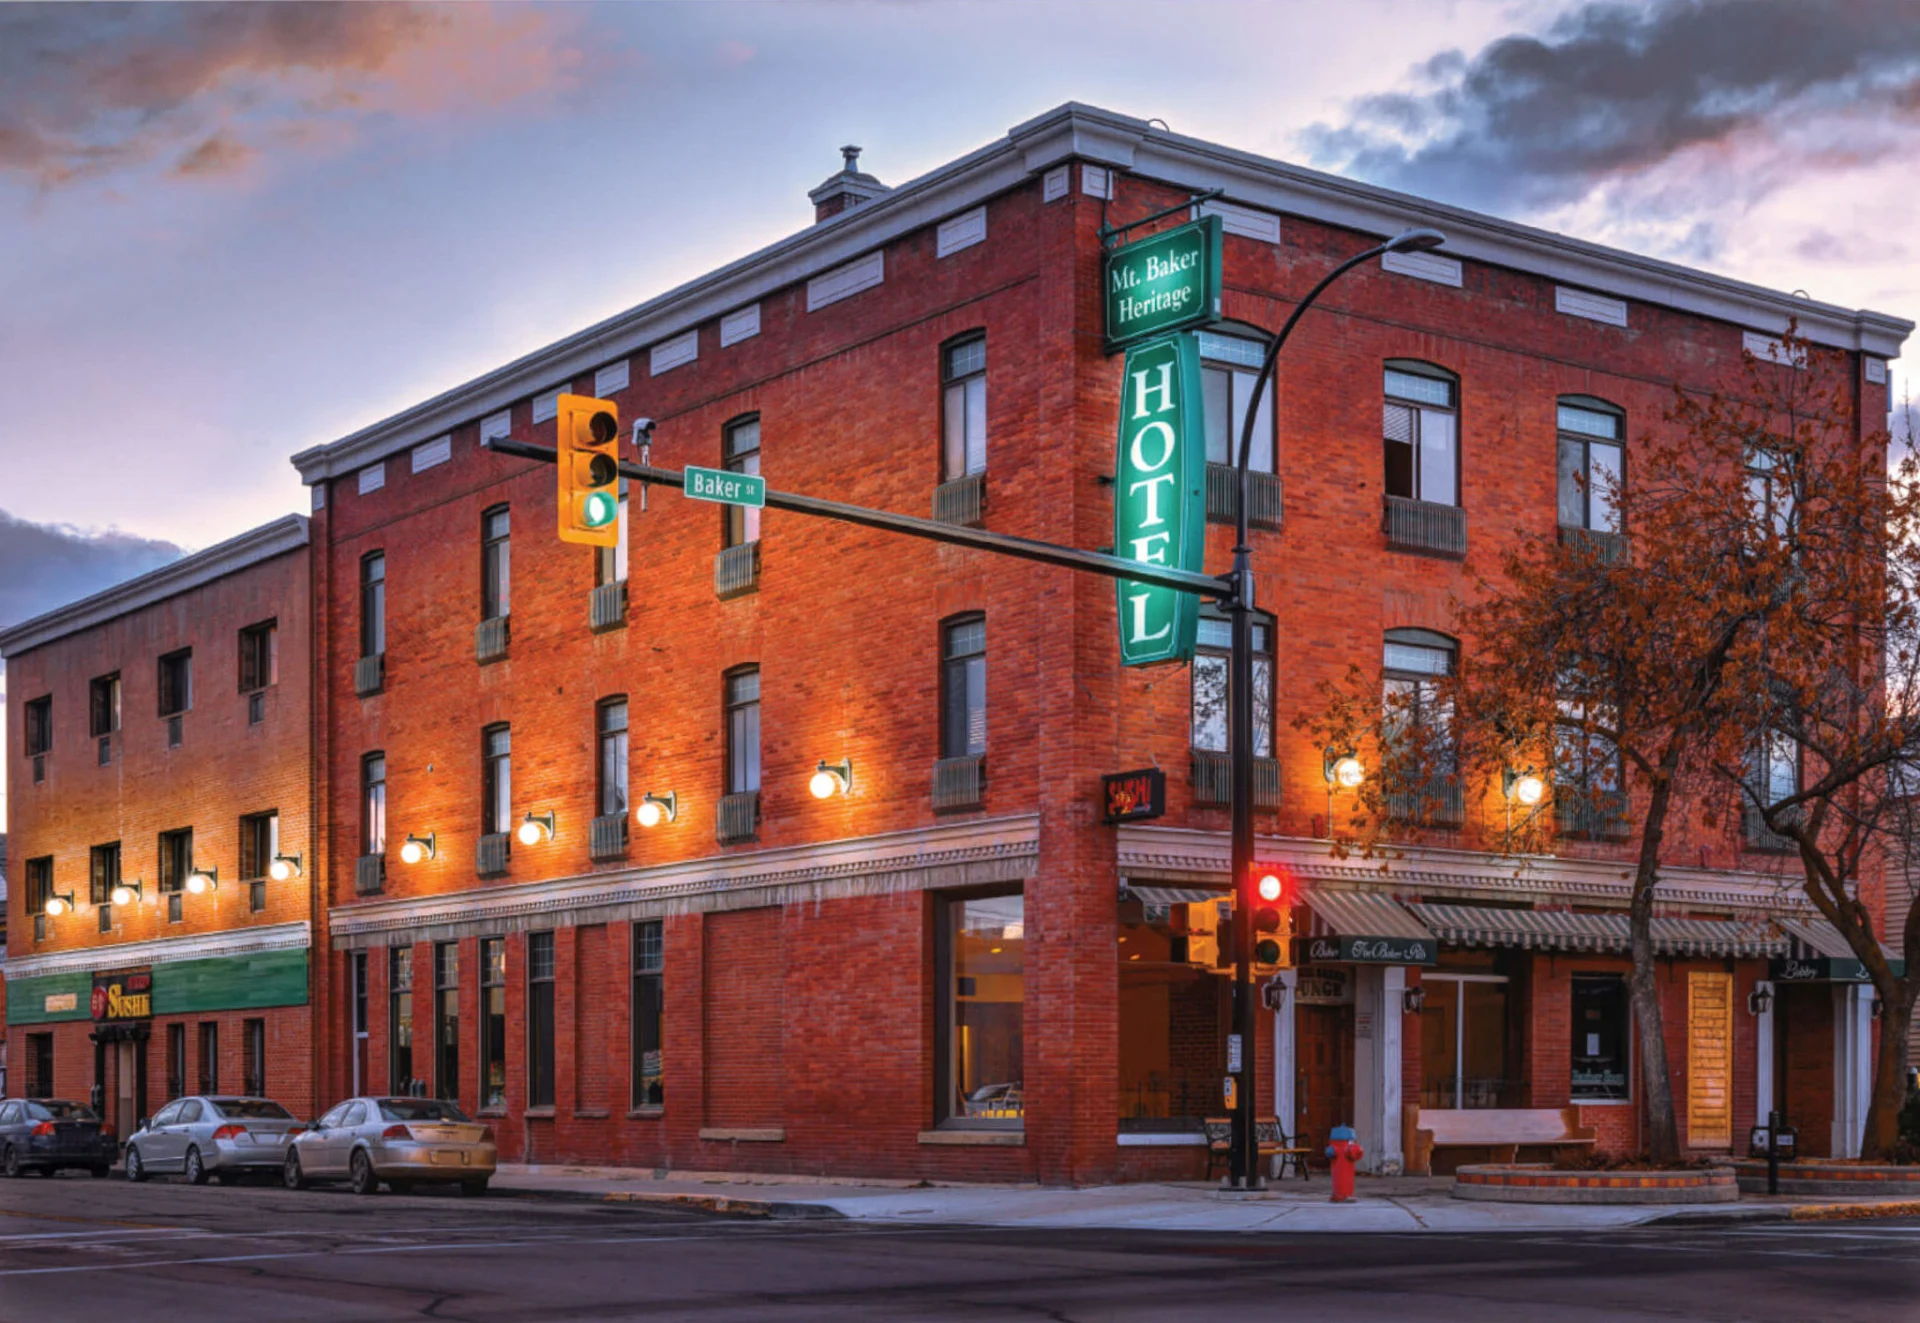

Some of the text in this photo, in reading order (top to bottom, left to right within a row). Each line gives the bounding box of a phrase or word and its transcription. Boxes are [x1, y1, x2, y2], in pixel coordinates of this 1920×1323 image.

[1112, 249, 1198, 293] Mt. Baker
[1119, 285, 1192, 324] Heritage
[694, 473, 742, 498] Baker
[1129, 361, 1176, 644] HOTEL
[1780, 960, 1818, 979] Lobby
